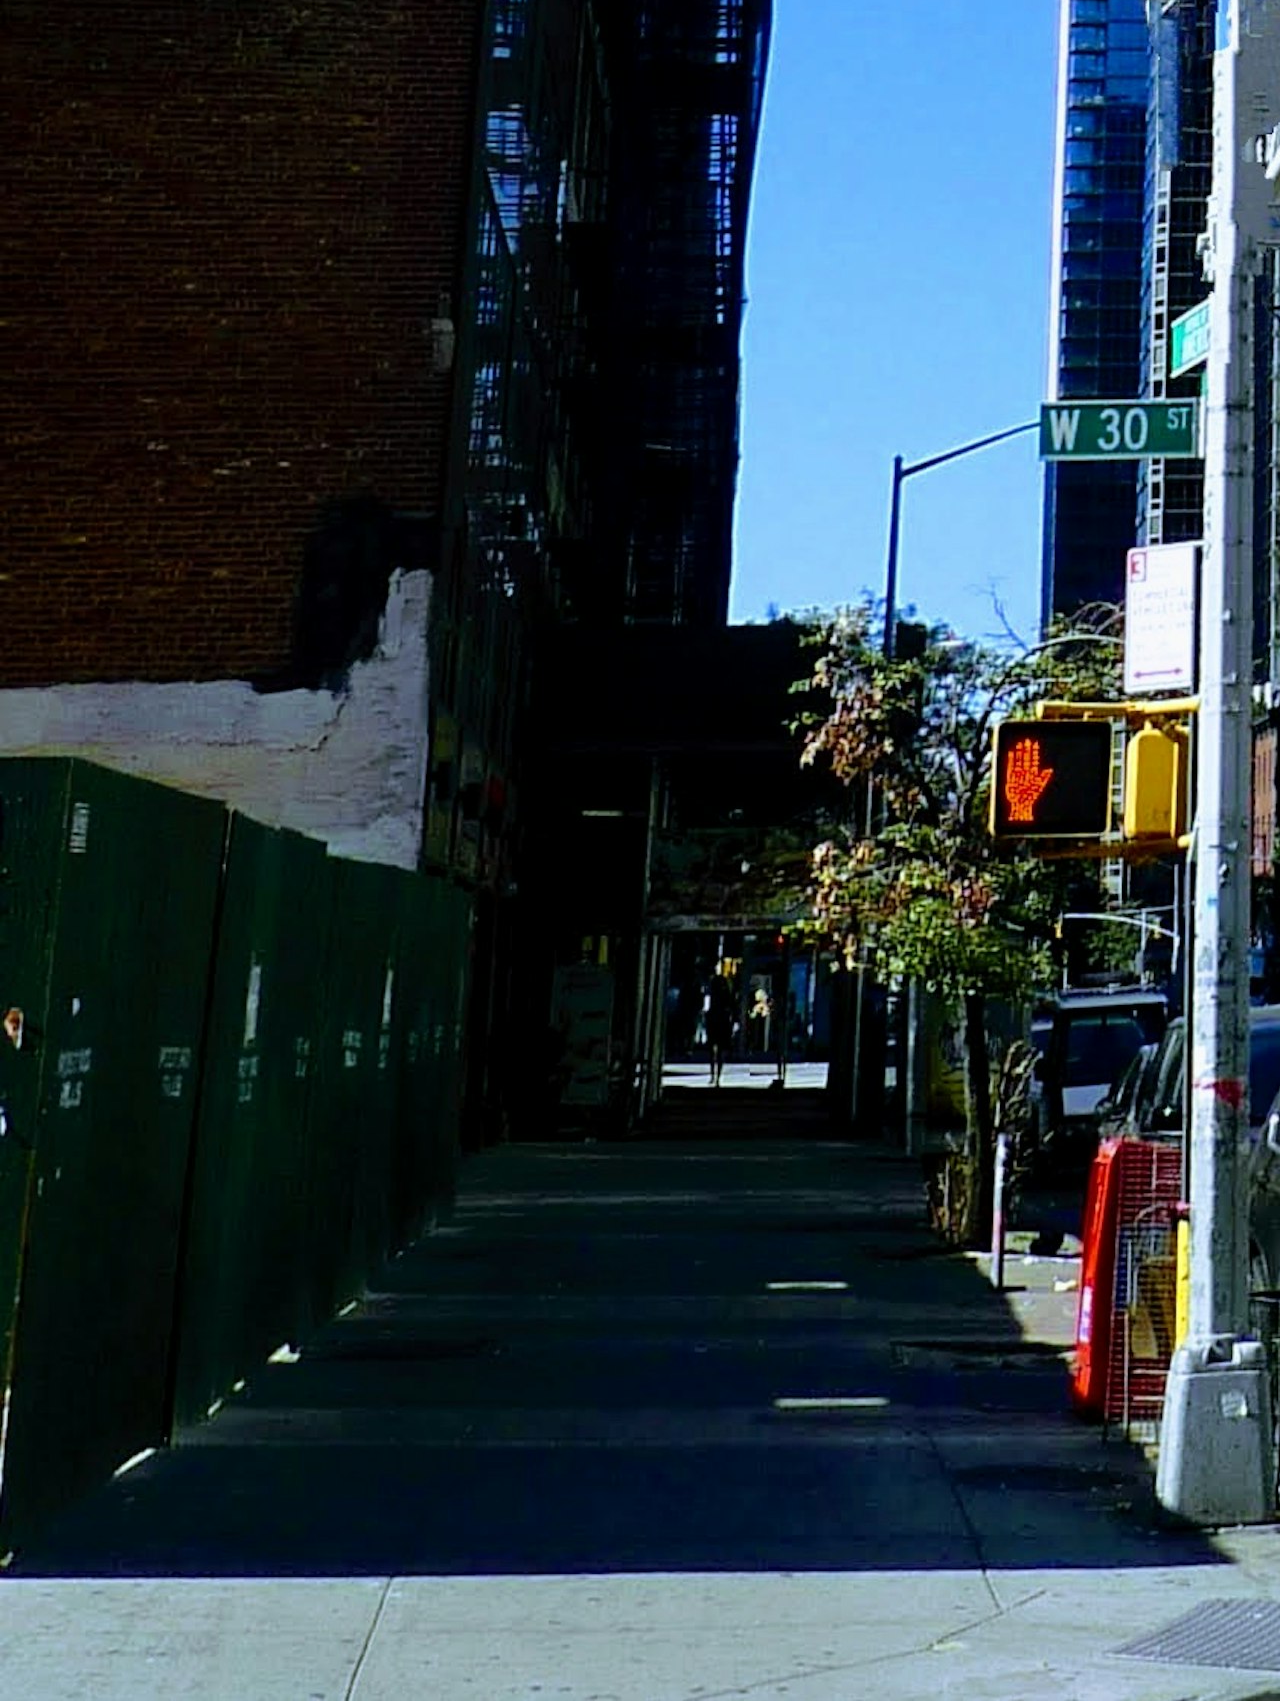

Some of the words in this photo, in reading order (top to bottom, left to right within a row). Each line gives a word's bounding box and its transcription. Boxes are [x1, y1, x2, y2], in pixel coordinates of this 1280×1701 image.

[1050, 410, 1081, 450] W
[1097, 408, 1148, 450] 30
[1167, 408, 1190, 429] ST
